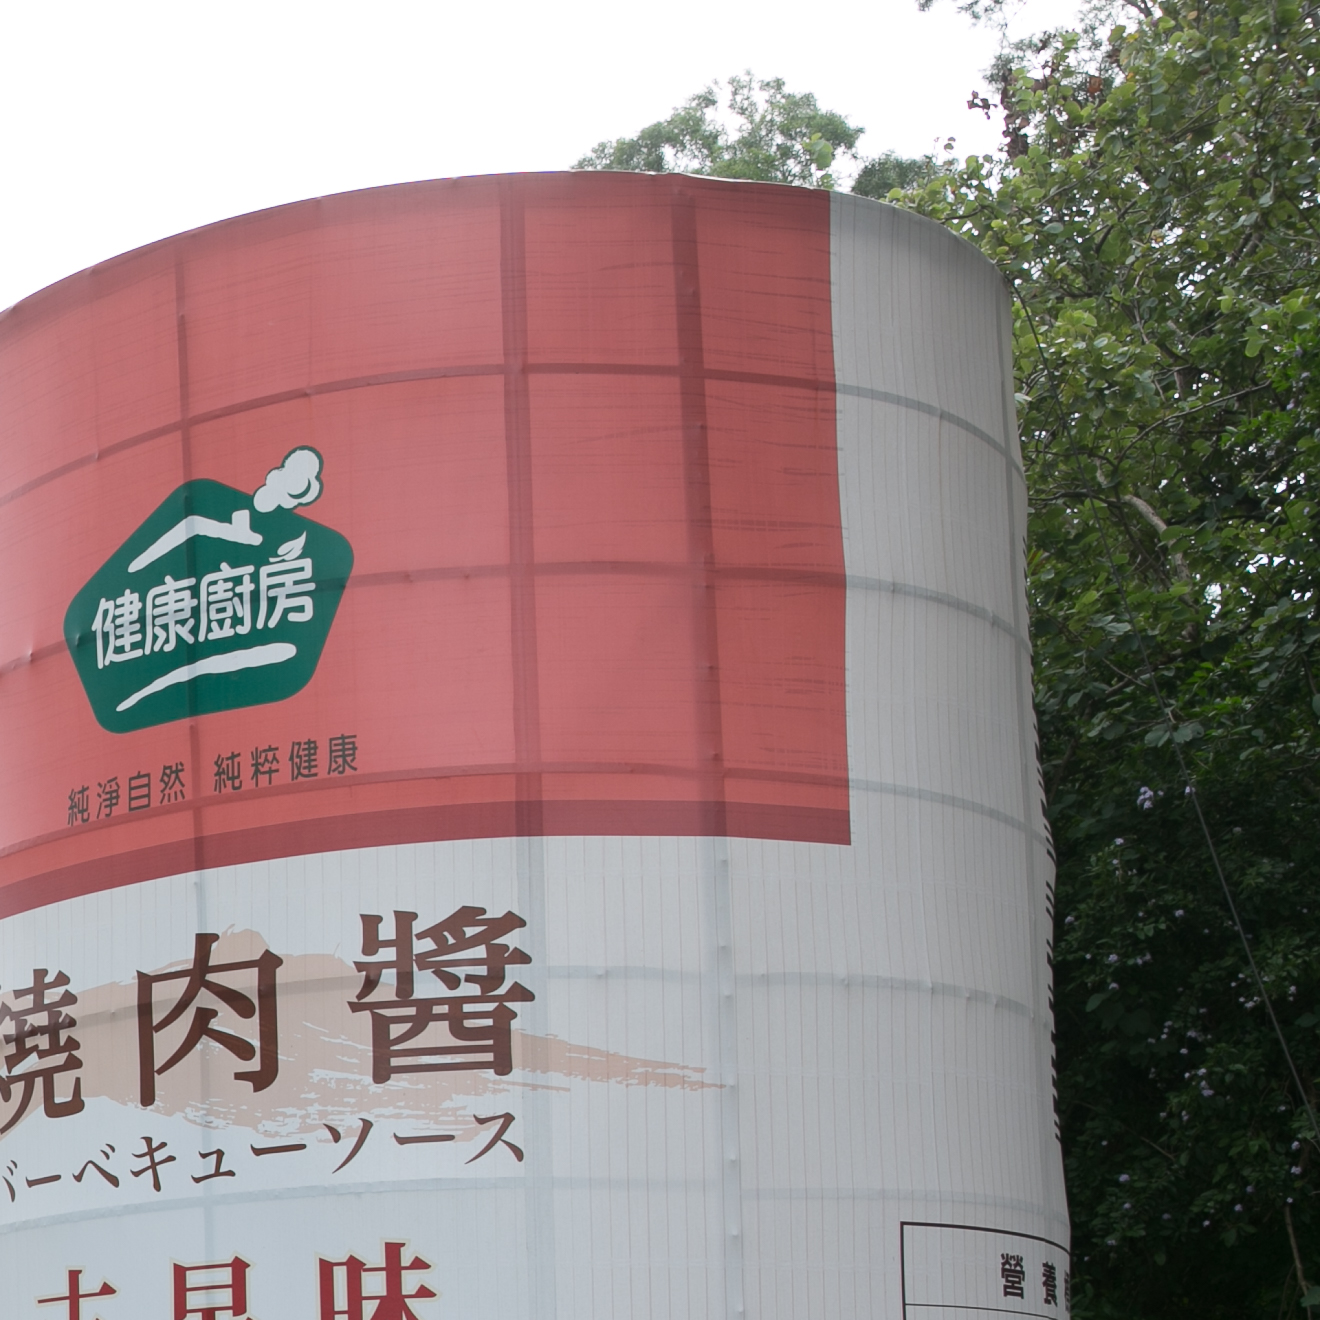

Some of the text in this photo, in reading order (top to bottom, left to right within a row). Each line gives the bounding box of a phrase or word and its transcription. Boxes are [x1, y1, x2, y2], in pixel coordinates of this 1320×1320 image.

[92, 540, 316, 669] 健康廚房
[67, 734, 359, 827] 純淨自然 純粹健康
